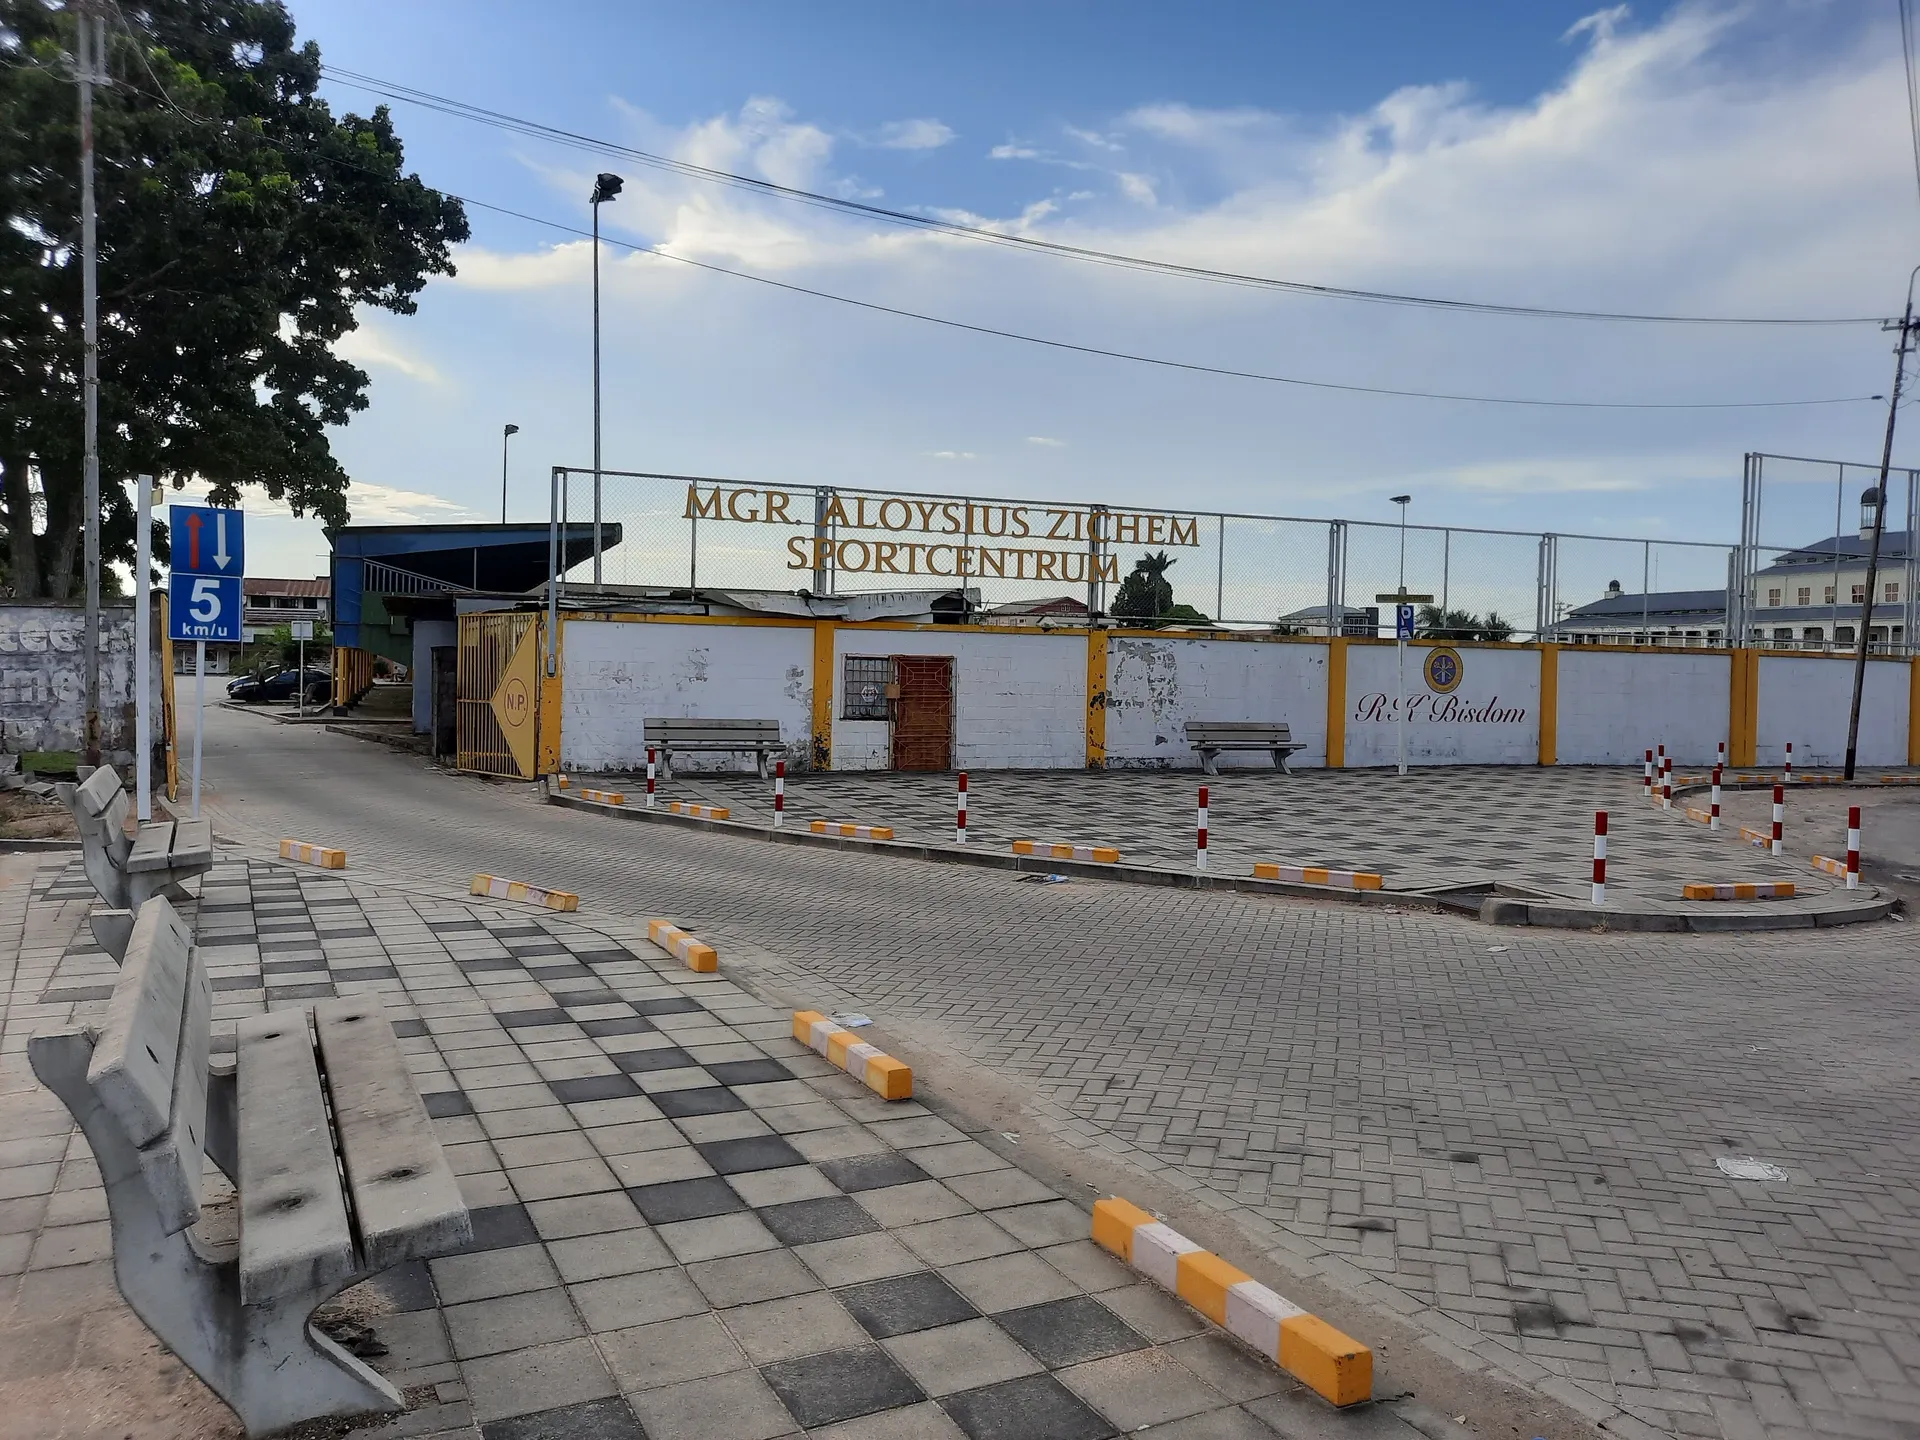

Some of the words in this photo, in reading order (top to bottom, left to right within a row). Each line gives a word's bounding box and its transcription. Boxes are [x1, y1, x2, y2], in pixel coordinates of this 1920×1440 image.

[682, 483, 802, 526] MGR.
[820, 494, 1030, 539] ALOYSIUS
[1045, 509, 1200, 547] ZICHEM
[787, 535, 1121, 584] SPORTCENTRUM
[189, 578, 222, 623] 5
[182, 622, 228, 637] km/u
[507, 693, 526, 711] N.P.
[1428, 694, 1527, 723] Bisdom
